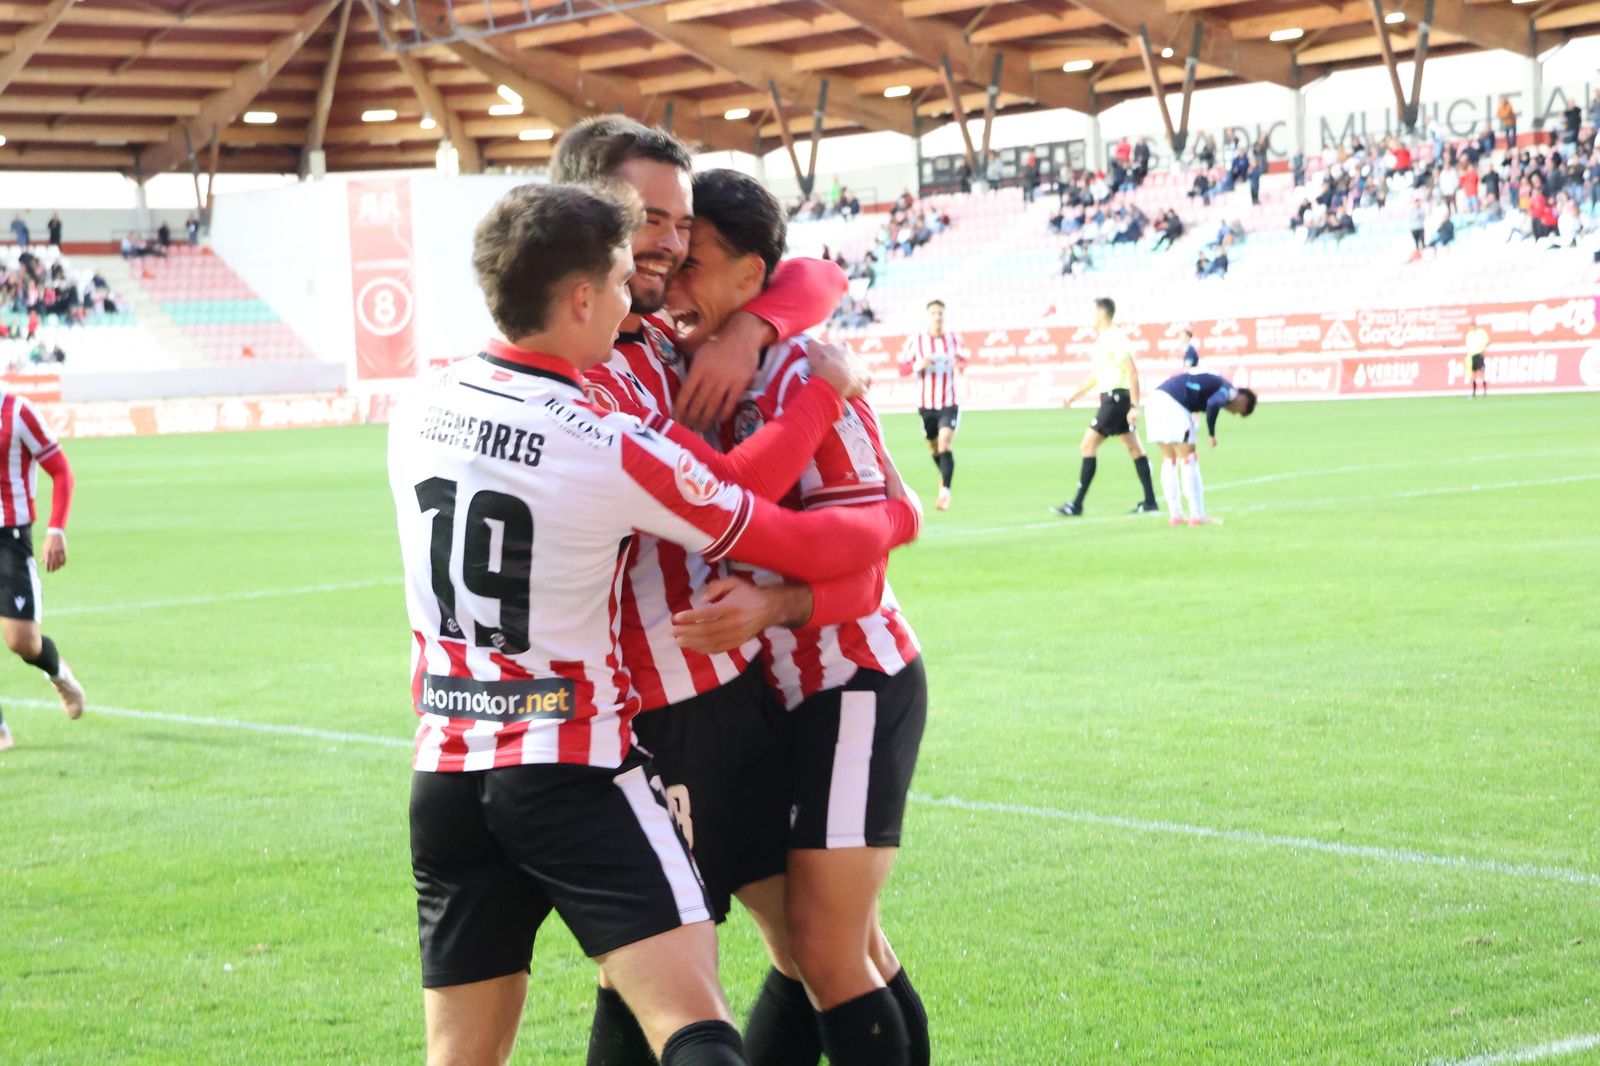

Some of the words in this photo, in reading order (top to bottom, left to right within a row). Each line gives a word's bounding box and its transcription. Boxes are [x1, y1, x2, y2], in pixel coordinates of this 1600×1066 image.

[374, 288, 396, 323] 8
[414, 475, 535, 655] 19
[422, 677, 570, 715] leomotor.net
